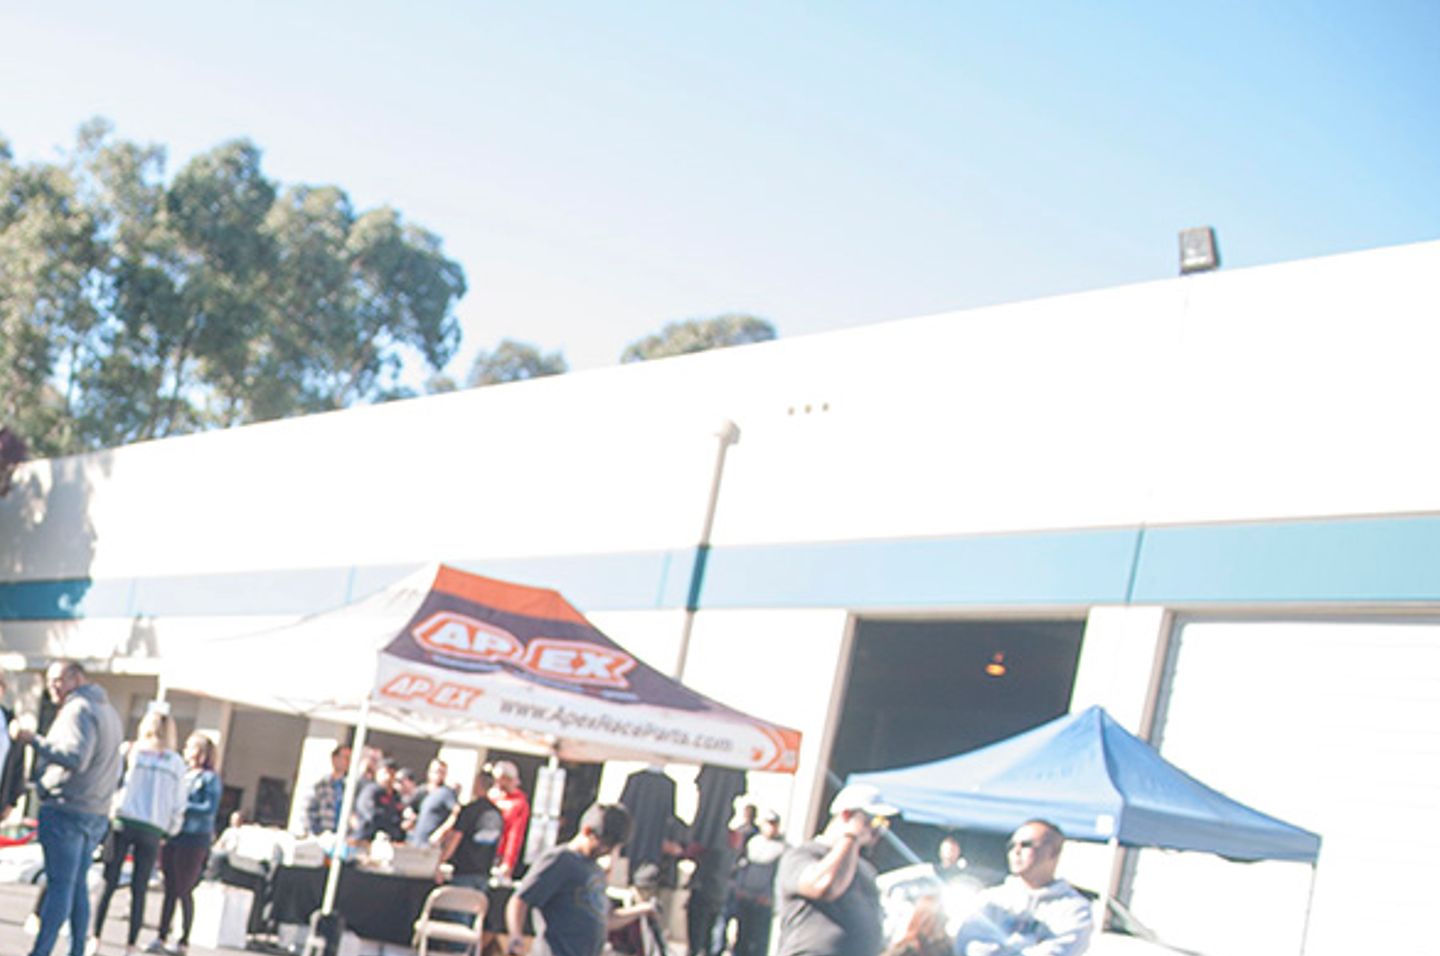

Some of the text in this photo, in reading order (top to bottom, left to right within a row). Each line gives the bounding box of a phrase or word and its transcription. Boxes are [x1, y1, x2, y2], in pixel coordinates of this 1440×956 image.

[420, 617, 627, 683] APEX
[381, 674, 482, 708] APEX
[499, 699, 734, 751] www.ApexRaceParts.com
